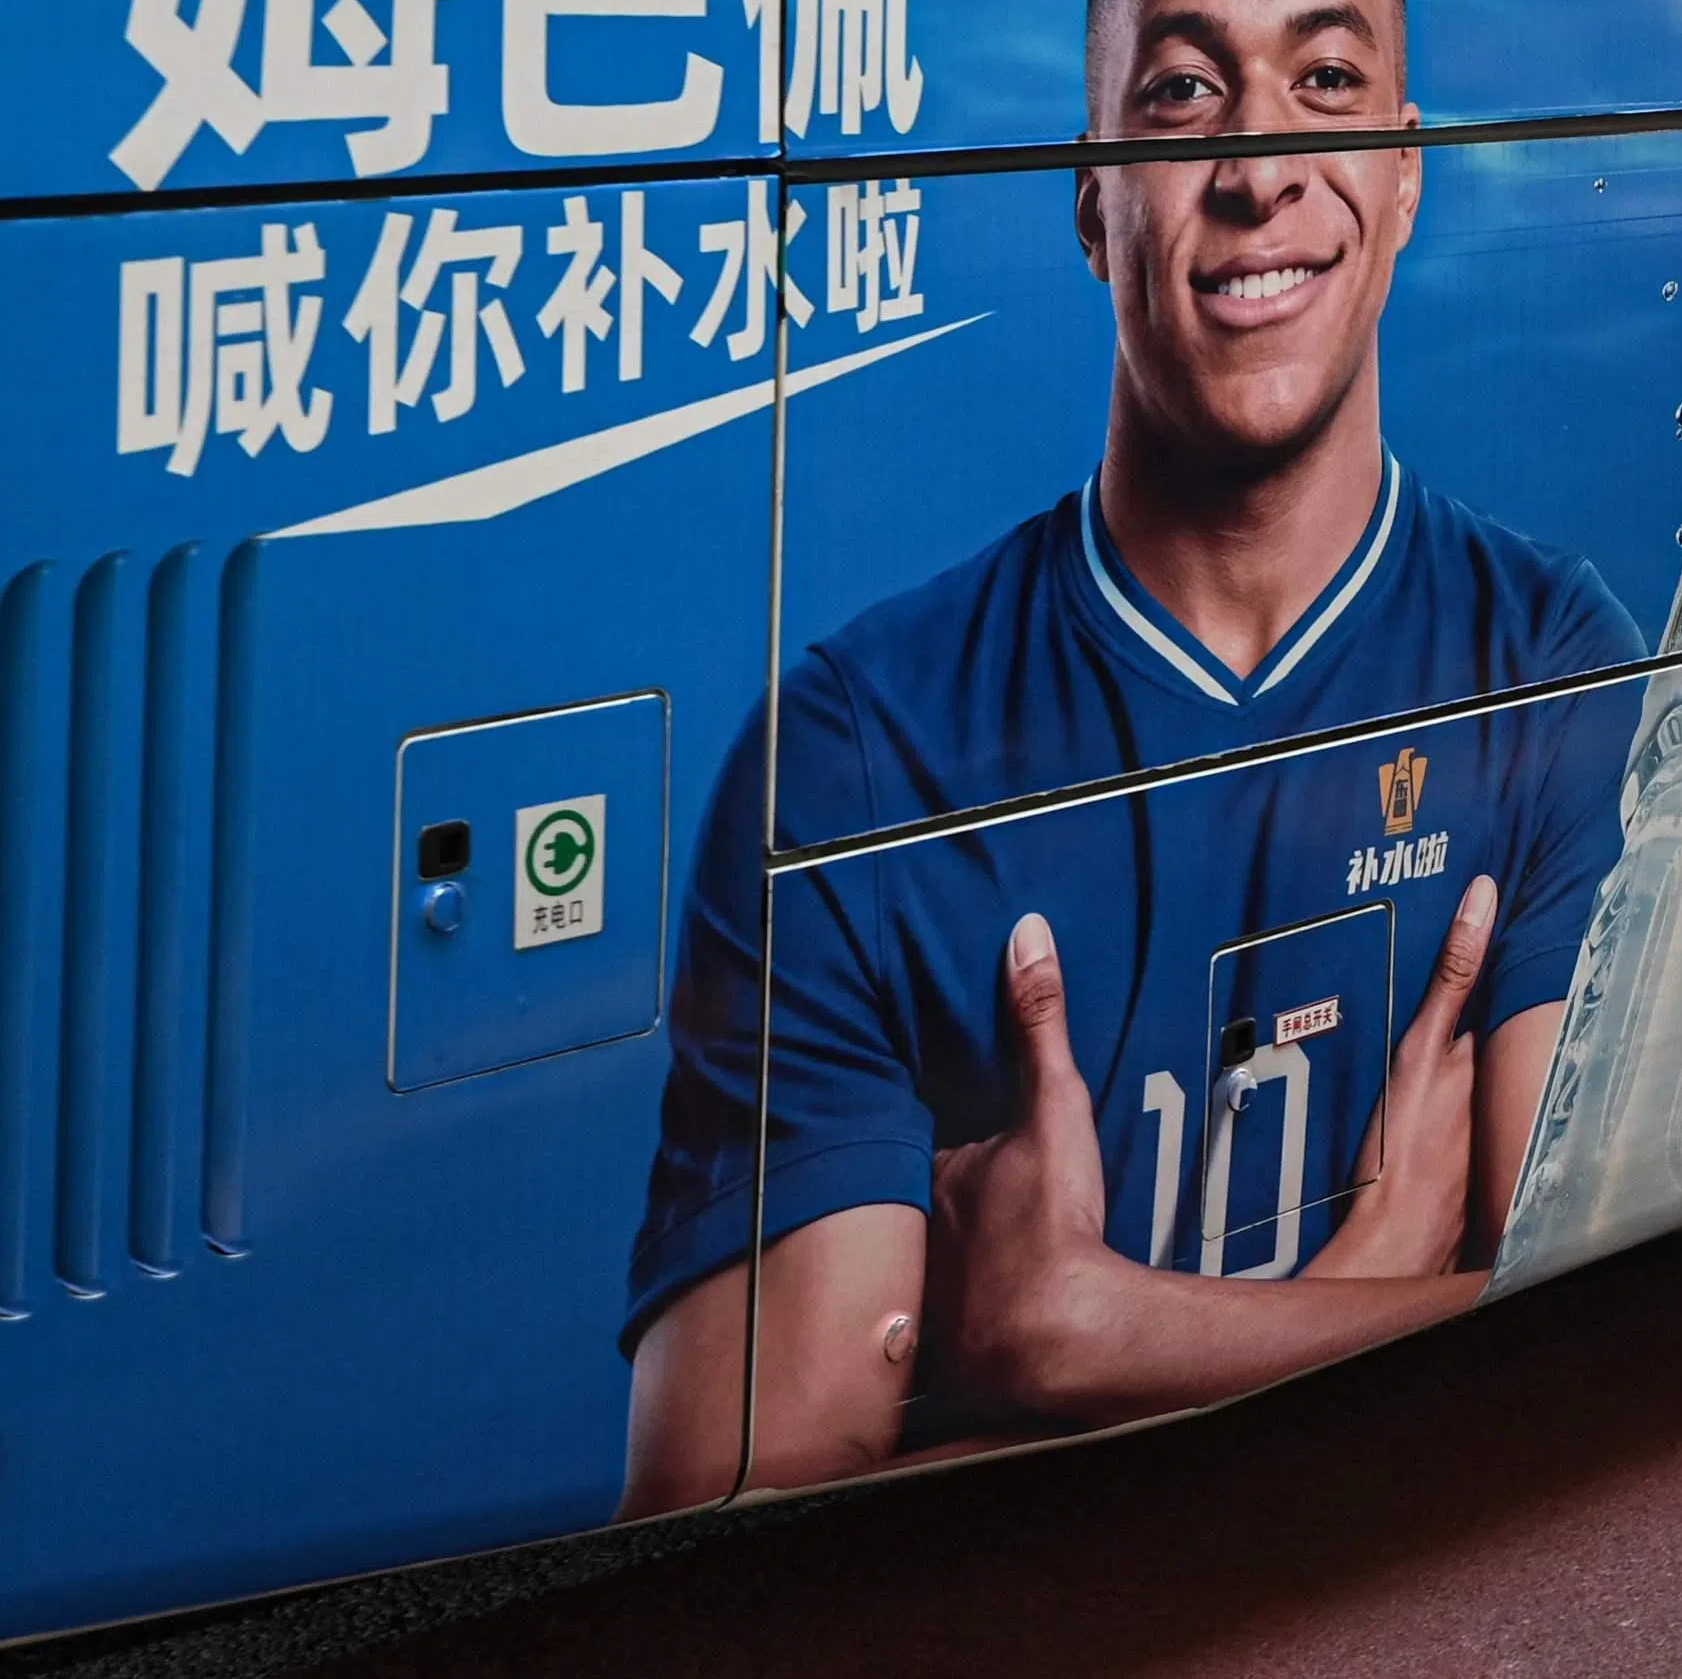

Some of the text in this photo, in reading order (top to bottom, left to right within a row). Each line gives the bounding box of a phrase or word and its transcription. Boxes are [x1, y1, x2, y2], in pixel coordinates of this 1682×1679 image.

[116, 179, 924, 477] 喊你补水啦
[531, 898, 585, 935] 充电口
[1346, 830, 1450, 896] 补水啦
[1142, 1041, 1312, 1280] 10
